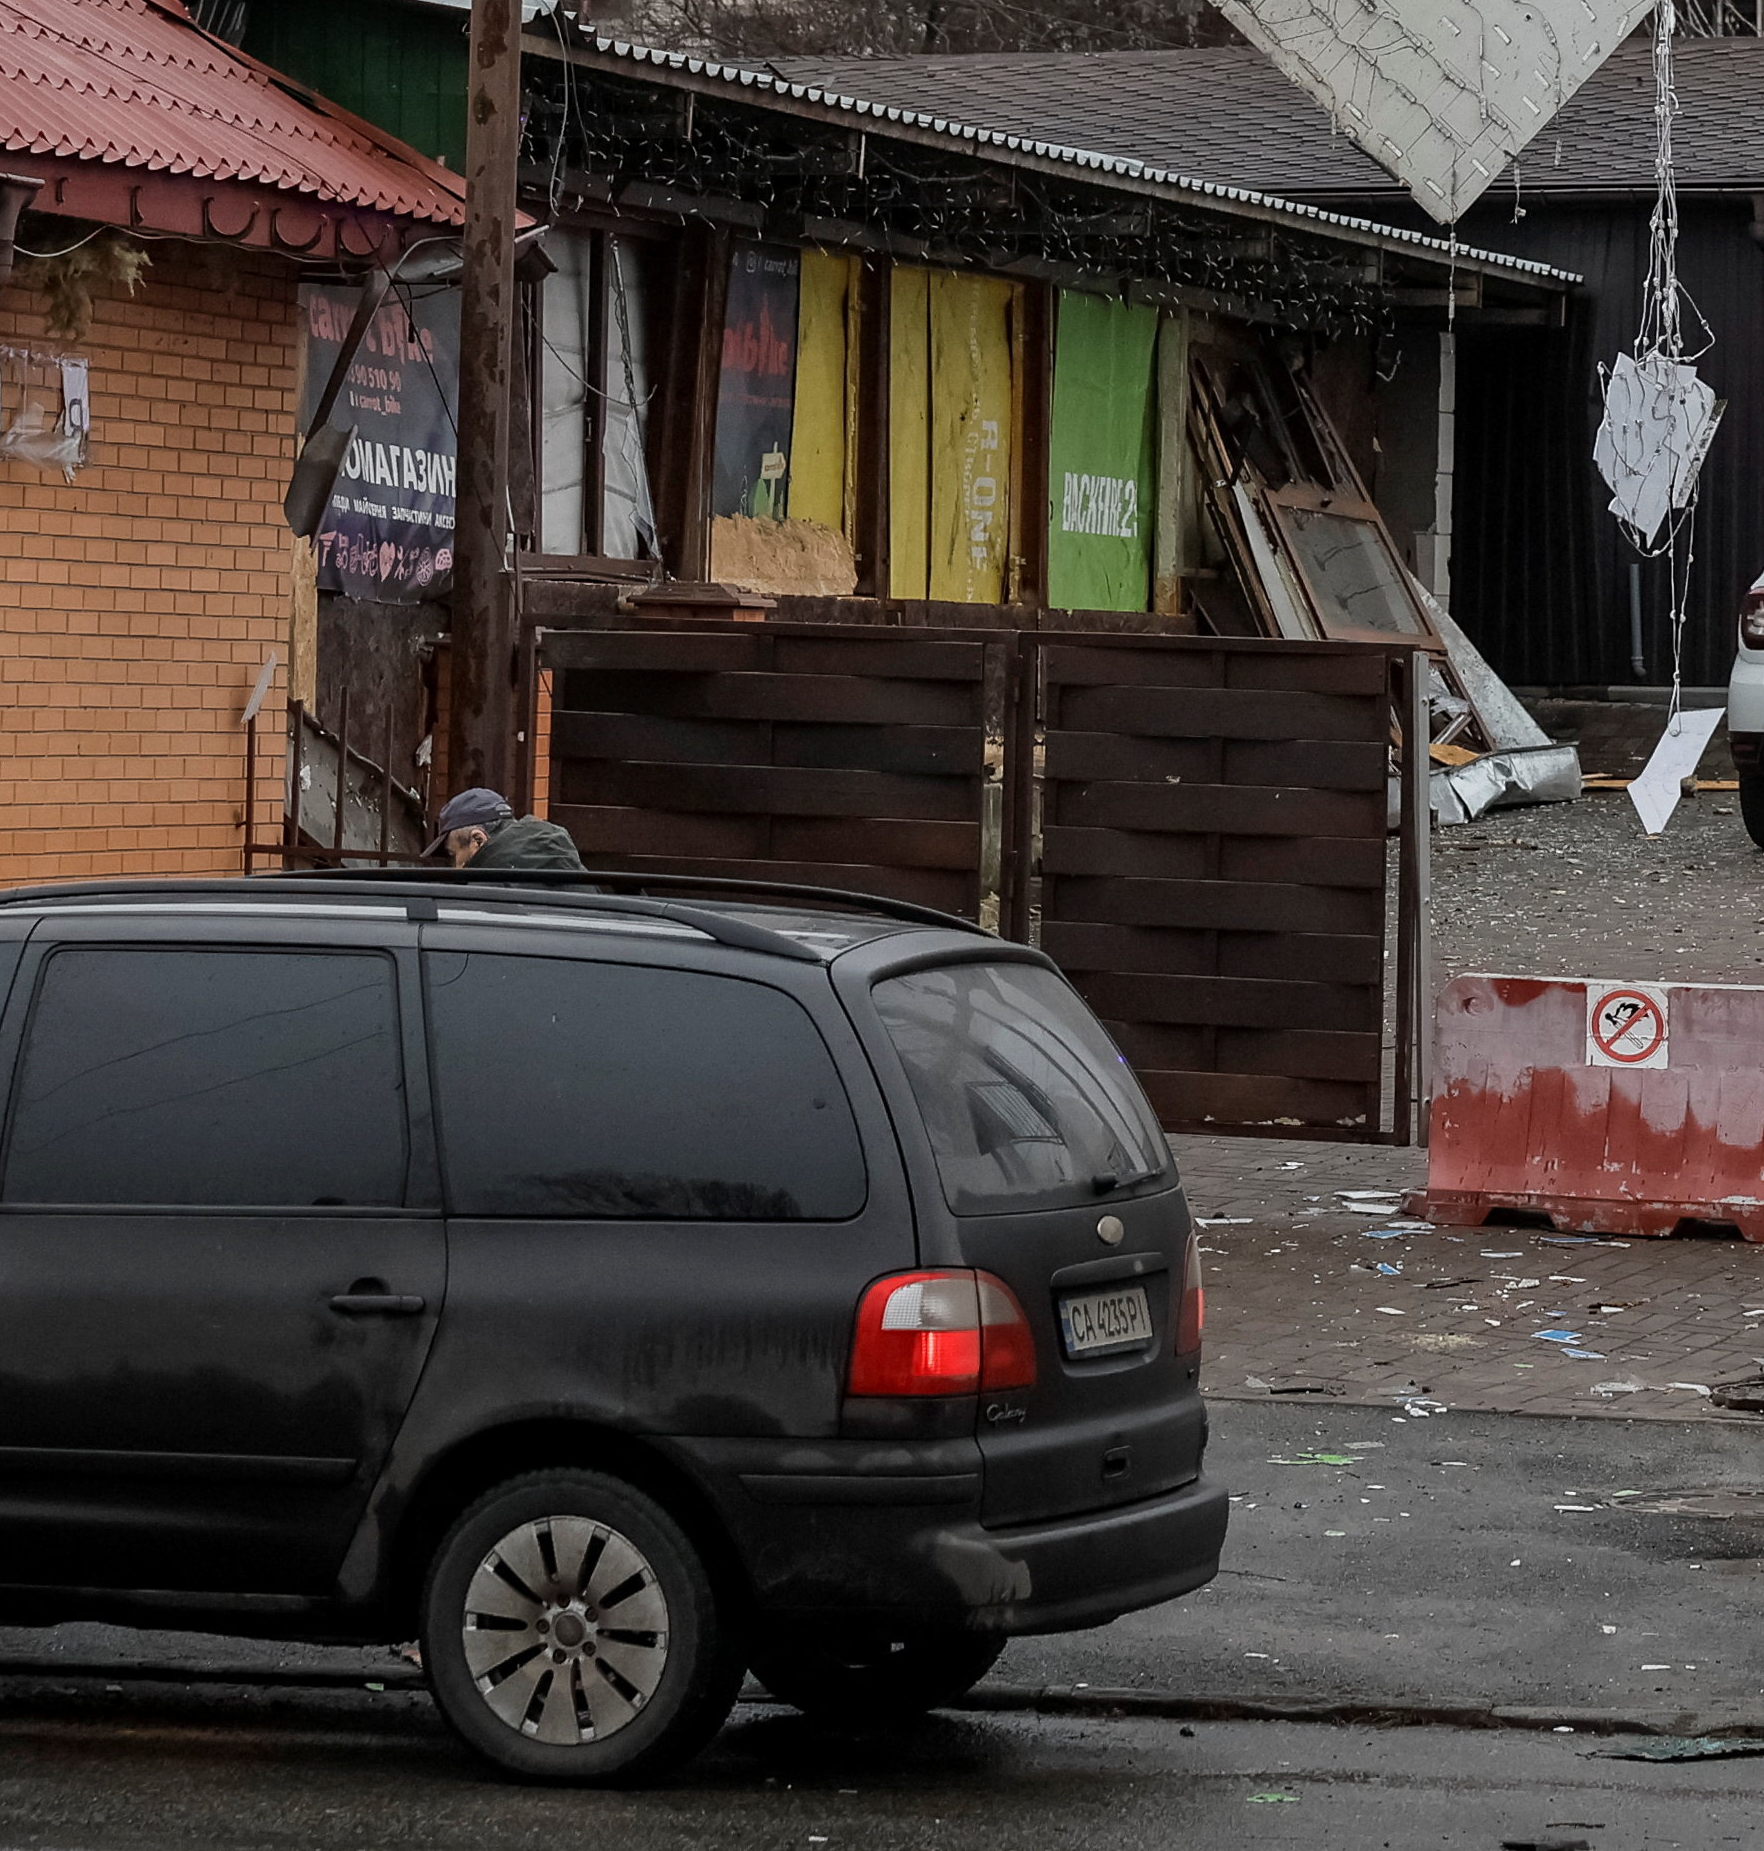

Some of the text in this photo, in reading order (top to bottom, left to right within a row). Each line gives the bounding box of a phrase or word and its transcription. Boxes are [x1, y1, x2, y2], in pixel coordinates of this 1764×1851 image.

[342, 439, 456, 497] ОМАГАЗИН
[1071, 1303, 1097, 1343] CA
[1098, 1297, 1129, 1338] 4235
